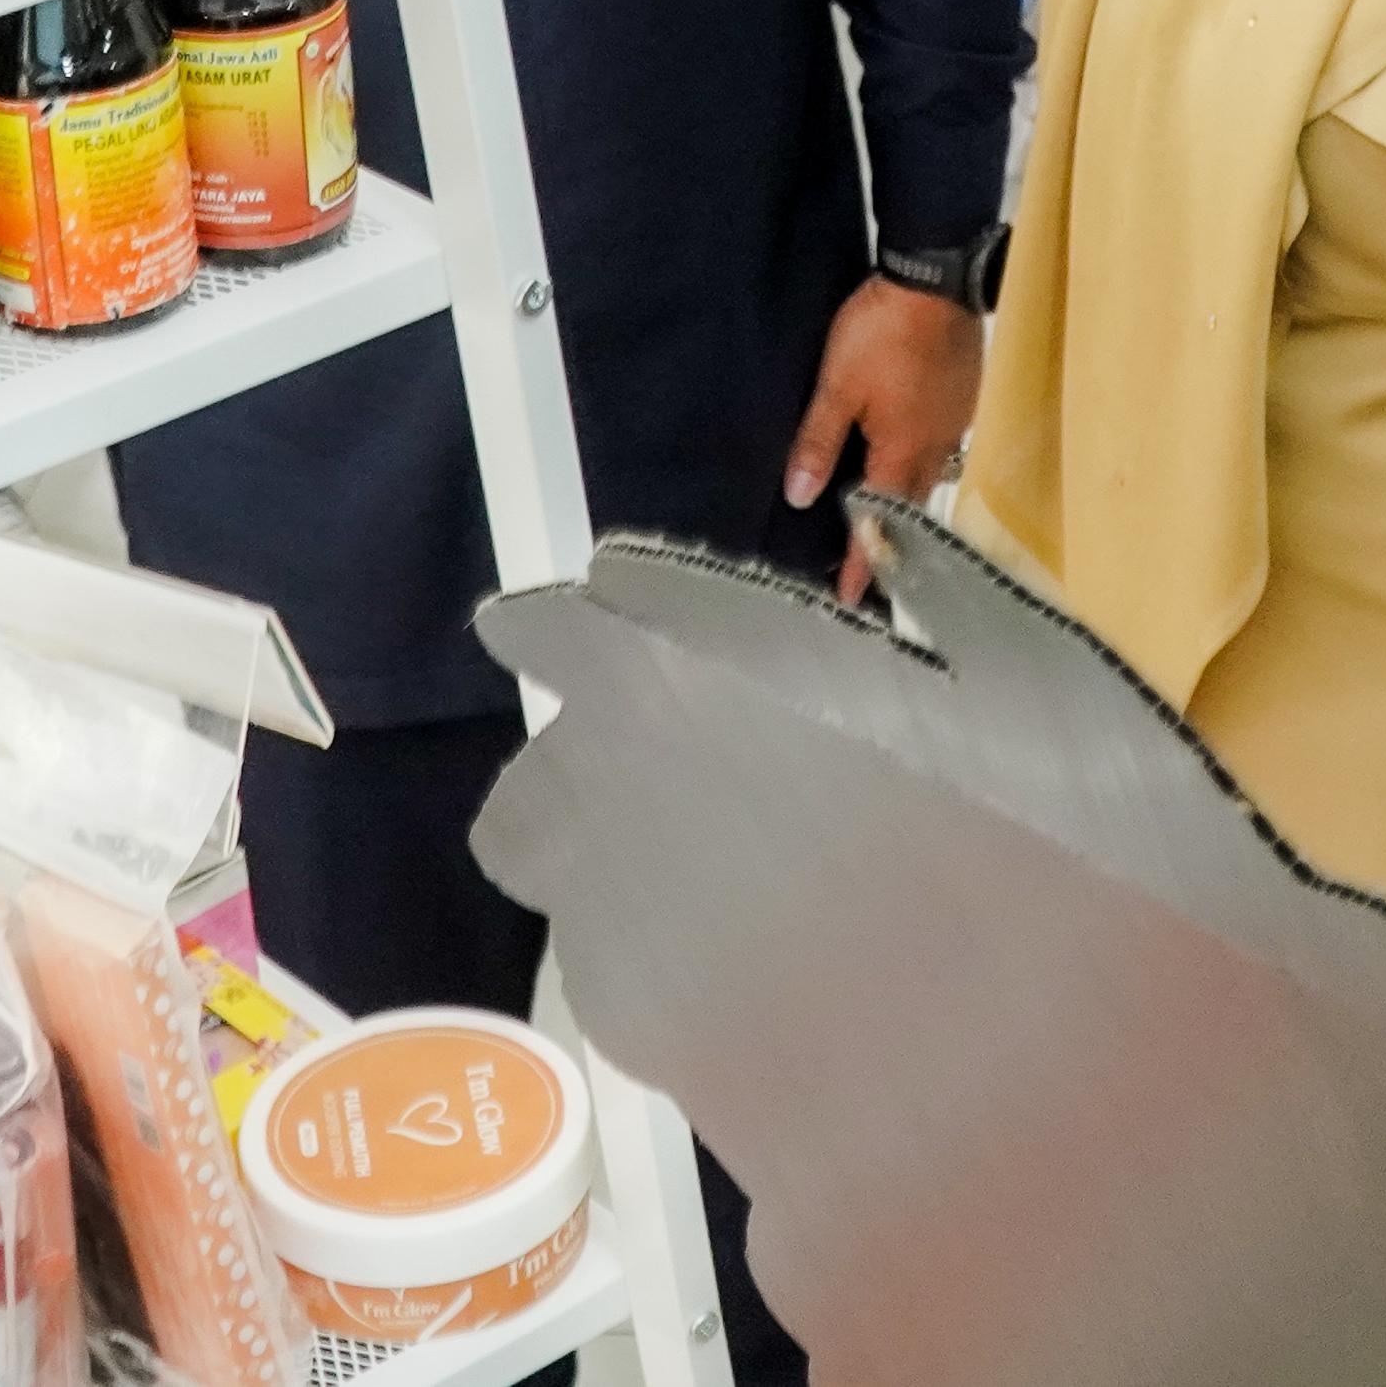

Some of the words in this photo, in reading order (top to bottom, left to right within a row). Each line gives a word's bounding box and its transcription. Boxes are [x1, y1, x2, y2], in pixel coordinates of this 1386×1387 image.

[208, 52, 245, 65] Jawa
[186, 69, 226, 87] ASAM
[230, 68, 272, 87] URAT
[73, 130, 126, 155] PEGAL
[471, 1100, 505, 1157] Glow
[508, 1249, 550, 1287] I'm
